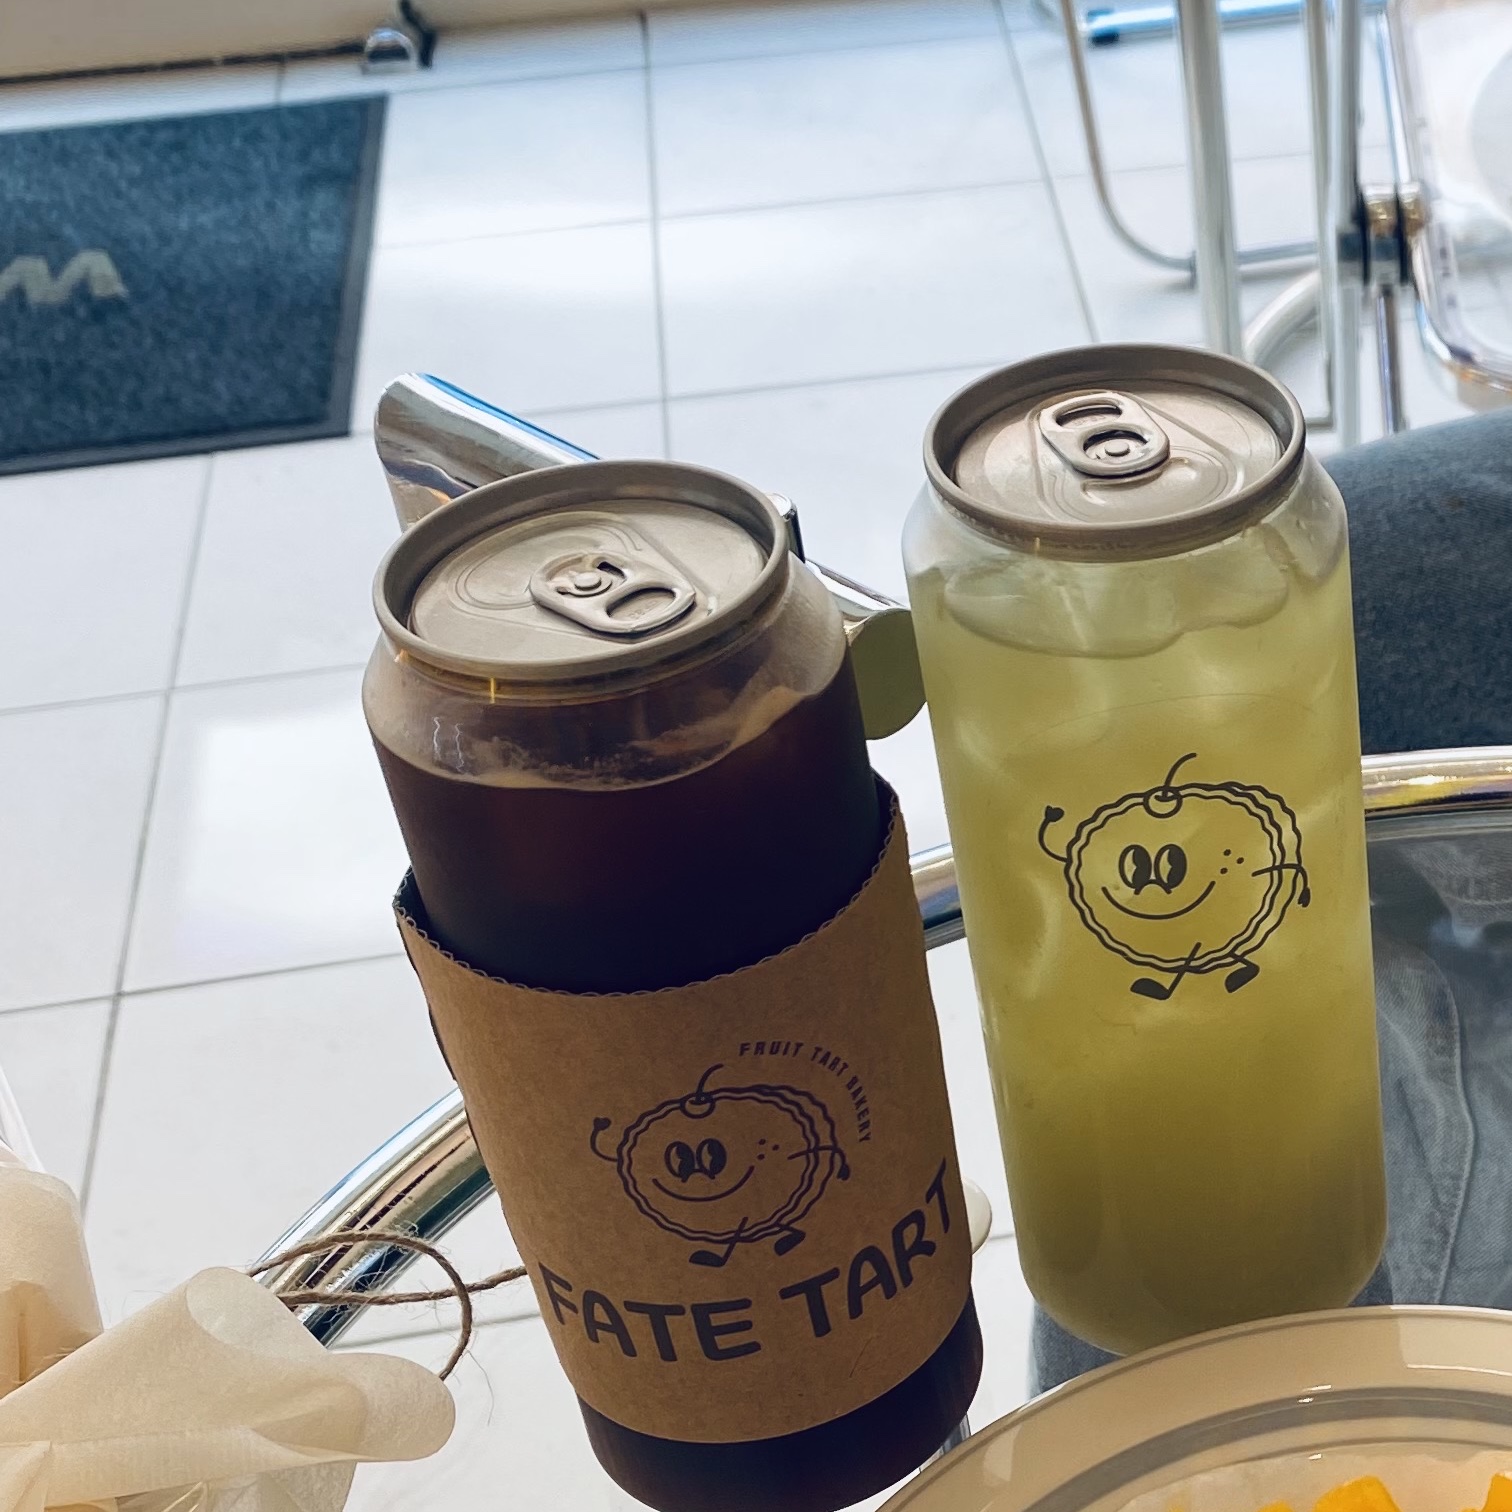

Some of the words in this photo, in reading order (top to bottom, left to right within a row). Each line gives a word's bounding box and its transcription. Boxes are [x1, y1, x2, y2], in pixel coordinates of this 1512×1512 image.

[738, 1040, 804, 1057] FRUIT
[811, 1046, 849, 1077] TART
[845, 1075, 872, 1143] BAKERY
[538, 1262, 762, 1362] FATE
[779, 1157, 953, 1338] TART
